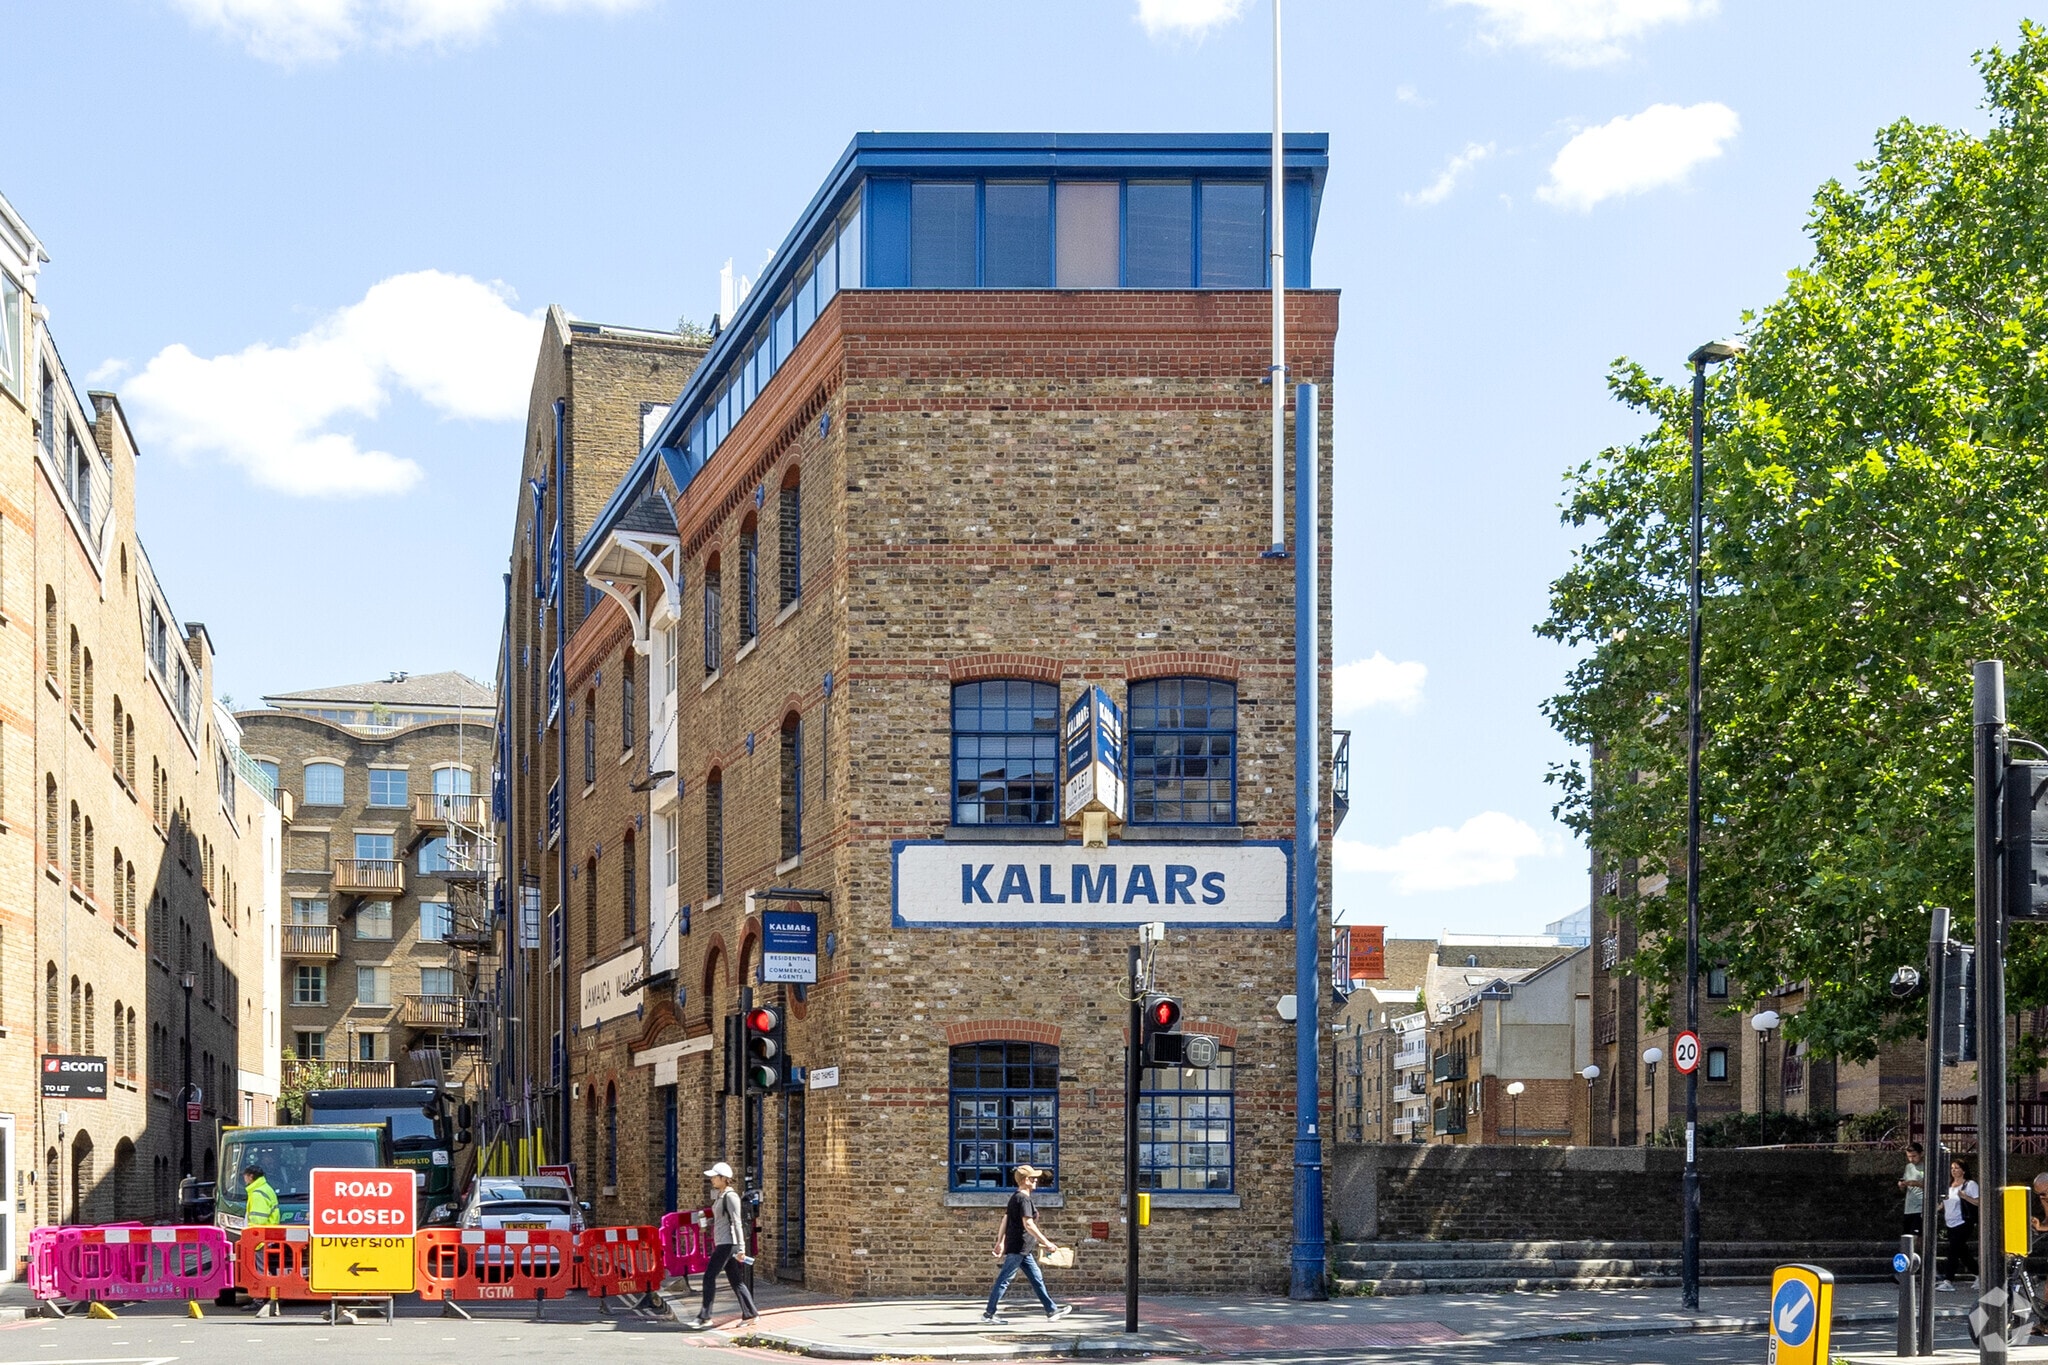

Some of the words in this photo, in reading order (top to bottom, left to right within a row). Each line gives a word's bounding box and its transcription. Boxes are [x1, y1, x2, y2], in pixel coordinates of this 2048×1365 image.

[961, 863, 1226, 905] KALMARs
[769, 923, 811, 931] KALMARs
[585, 978, 611, 1010] JAMAICA
[1677, 1043, 1696, 1061] 20
[61, 1061, 104, 1072] acorn
[417, 1157, 430, 1165] LTD
[335, 1181, 393, 1197] ROAD
[321, 1208, 405, 1225] CLOSED
[321, 1237, 405, 1248] Diversion
[477, 1286, 514, 1298] TGTM
